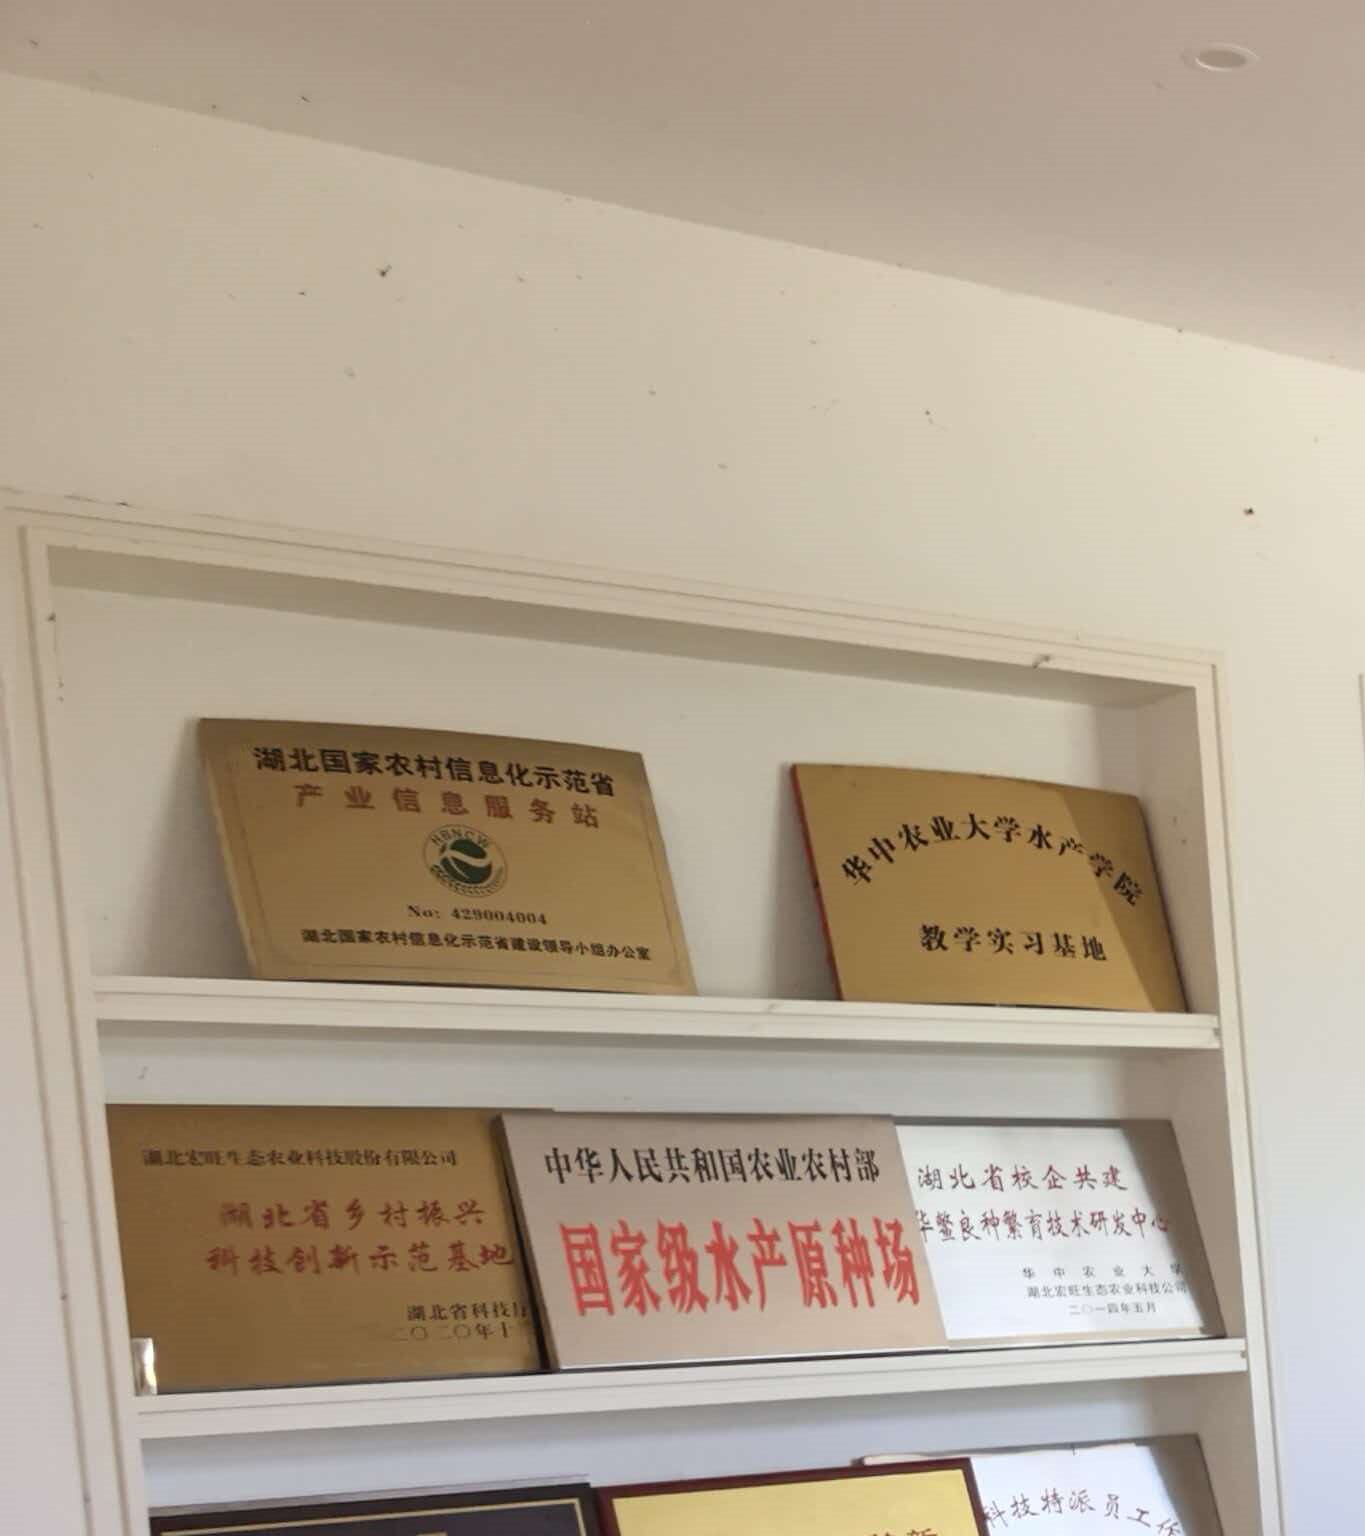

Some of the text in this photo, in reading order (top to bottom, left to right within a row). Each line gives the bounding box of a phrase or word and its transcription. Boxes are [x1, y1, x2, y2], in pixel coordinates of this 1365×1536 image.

[253, 746, 614, 797] 湖北国家农村信息化示范省
[295, 783, 599, 828] 产业信息服务站
[842, 813, 1144, 905] 华中农业大学水产学院
[301, 928, 651, 961] 湖北国家农村信息化示范省建设领导小组办公室
[920, 924, 1107, 961] 教学实习基地
[544, 1146, 881, 1184] 中华人民共和国农业农村部
[918, 1163, 1129, 1192] 湖北省校企共建
[220, 1198, 486, 1230] 湖北省乡村振兴
[206, 1240, 514, 1275] 科技创新示范基地
[559, 1215, 921, 1317] 国家级水产原种场
